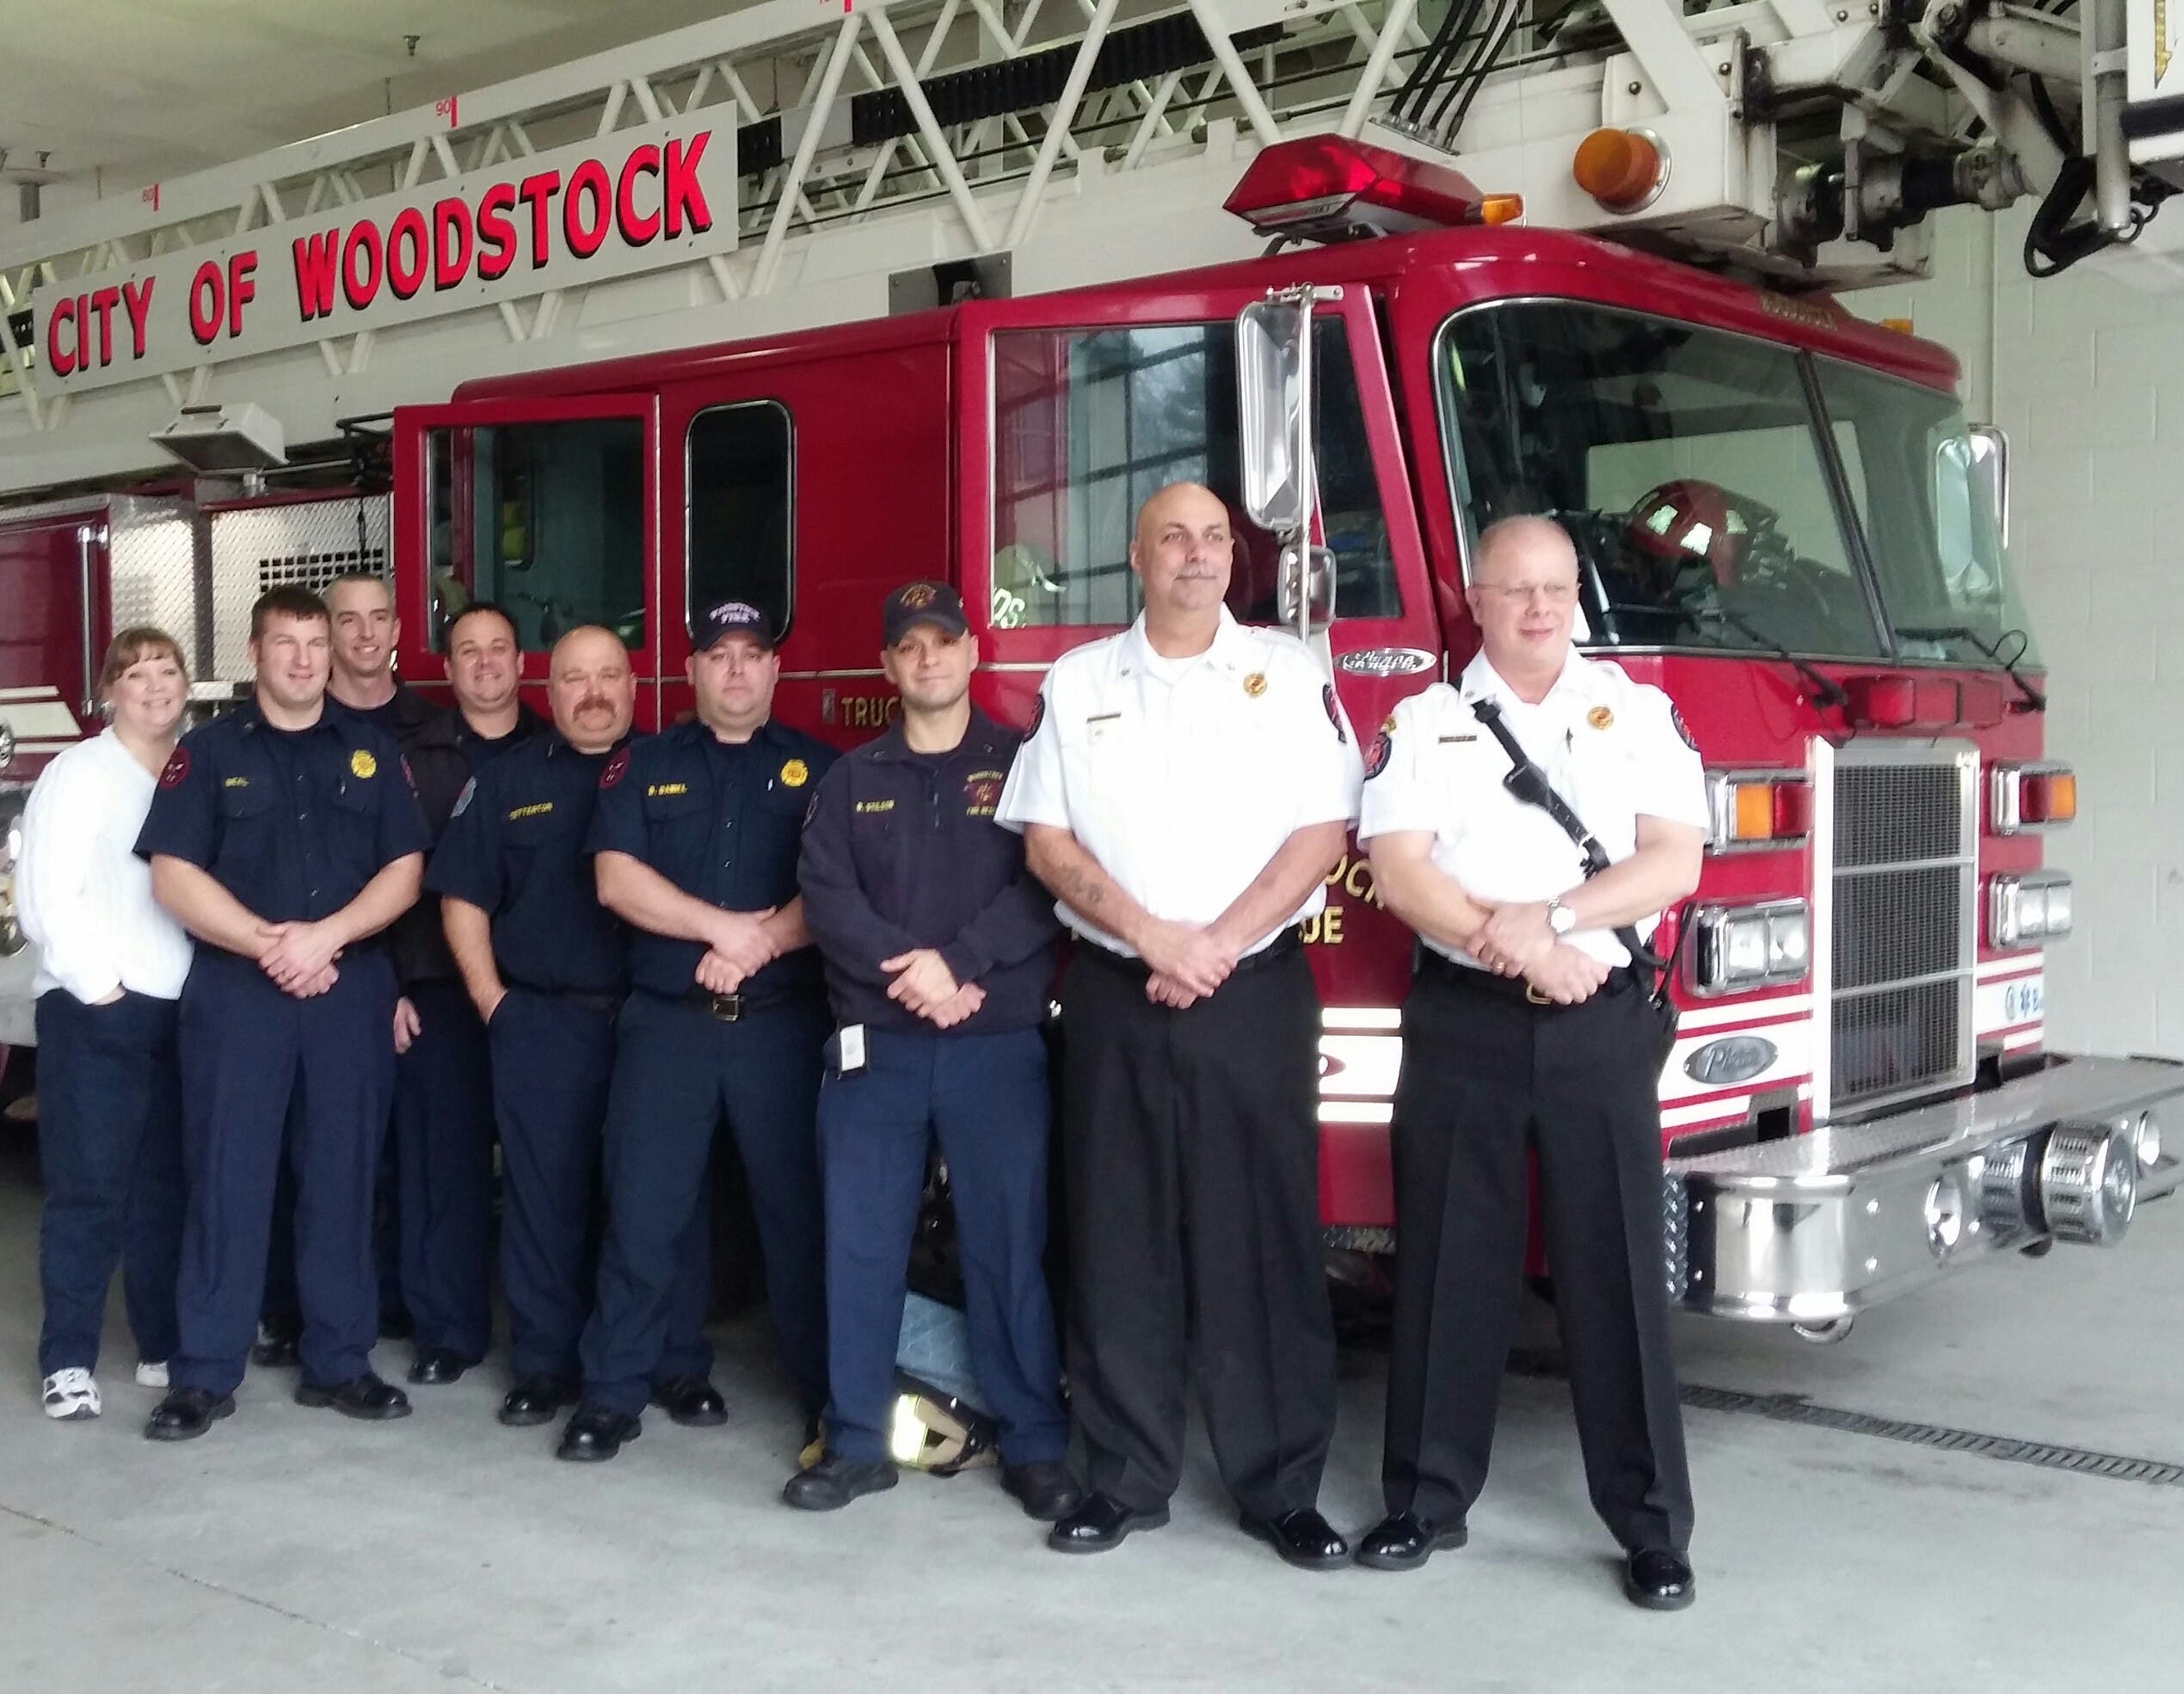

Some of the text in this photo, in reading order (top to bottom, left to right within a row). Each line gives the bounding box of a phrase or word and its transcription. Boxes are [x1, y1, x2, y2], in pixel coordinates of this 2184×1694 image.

[435, 99, 451, 116] 90
[48, 131, 712, 377] CITY OF WOODSTOCK
[840, 697, 901, 728] TRUC
